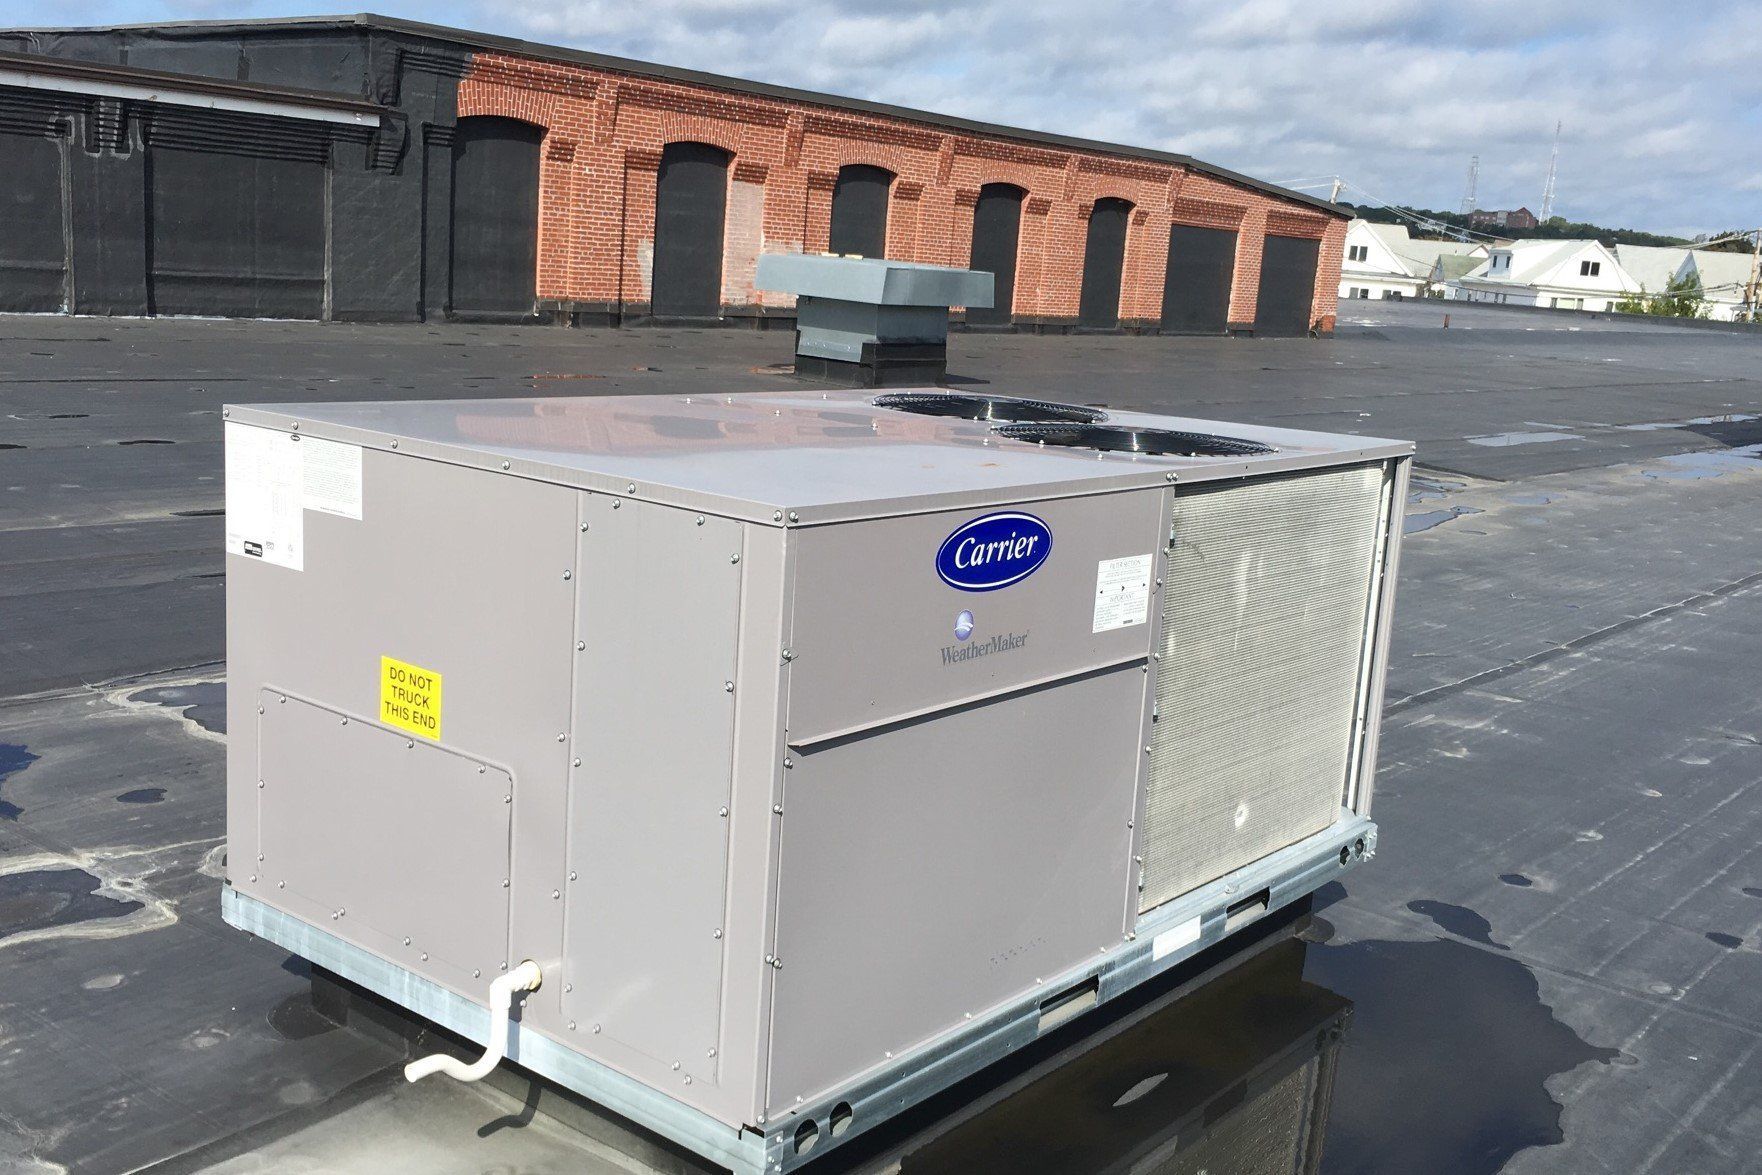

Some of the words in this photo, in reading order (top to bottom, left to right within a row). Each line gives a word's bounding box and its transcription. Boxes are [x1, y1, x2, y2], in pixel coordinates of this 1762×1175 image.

[955, 531, 1039, 569] Carrier
[940, 632, 1029, 666] WeatherMaker
[390, 666, 406, 682] DO
[409, 673, 432, 691] NOT
[392, 685, 430, 709] TRUCK
[385, 700, 409, 721] THIS
[412, 710, 436, 729] END
